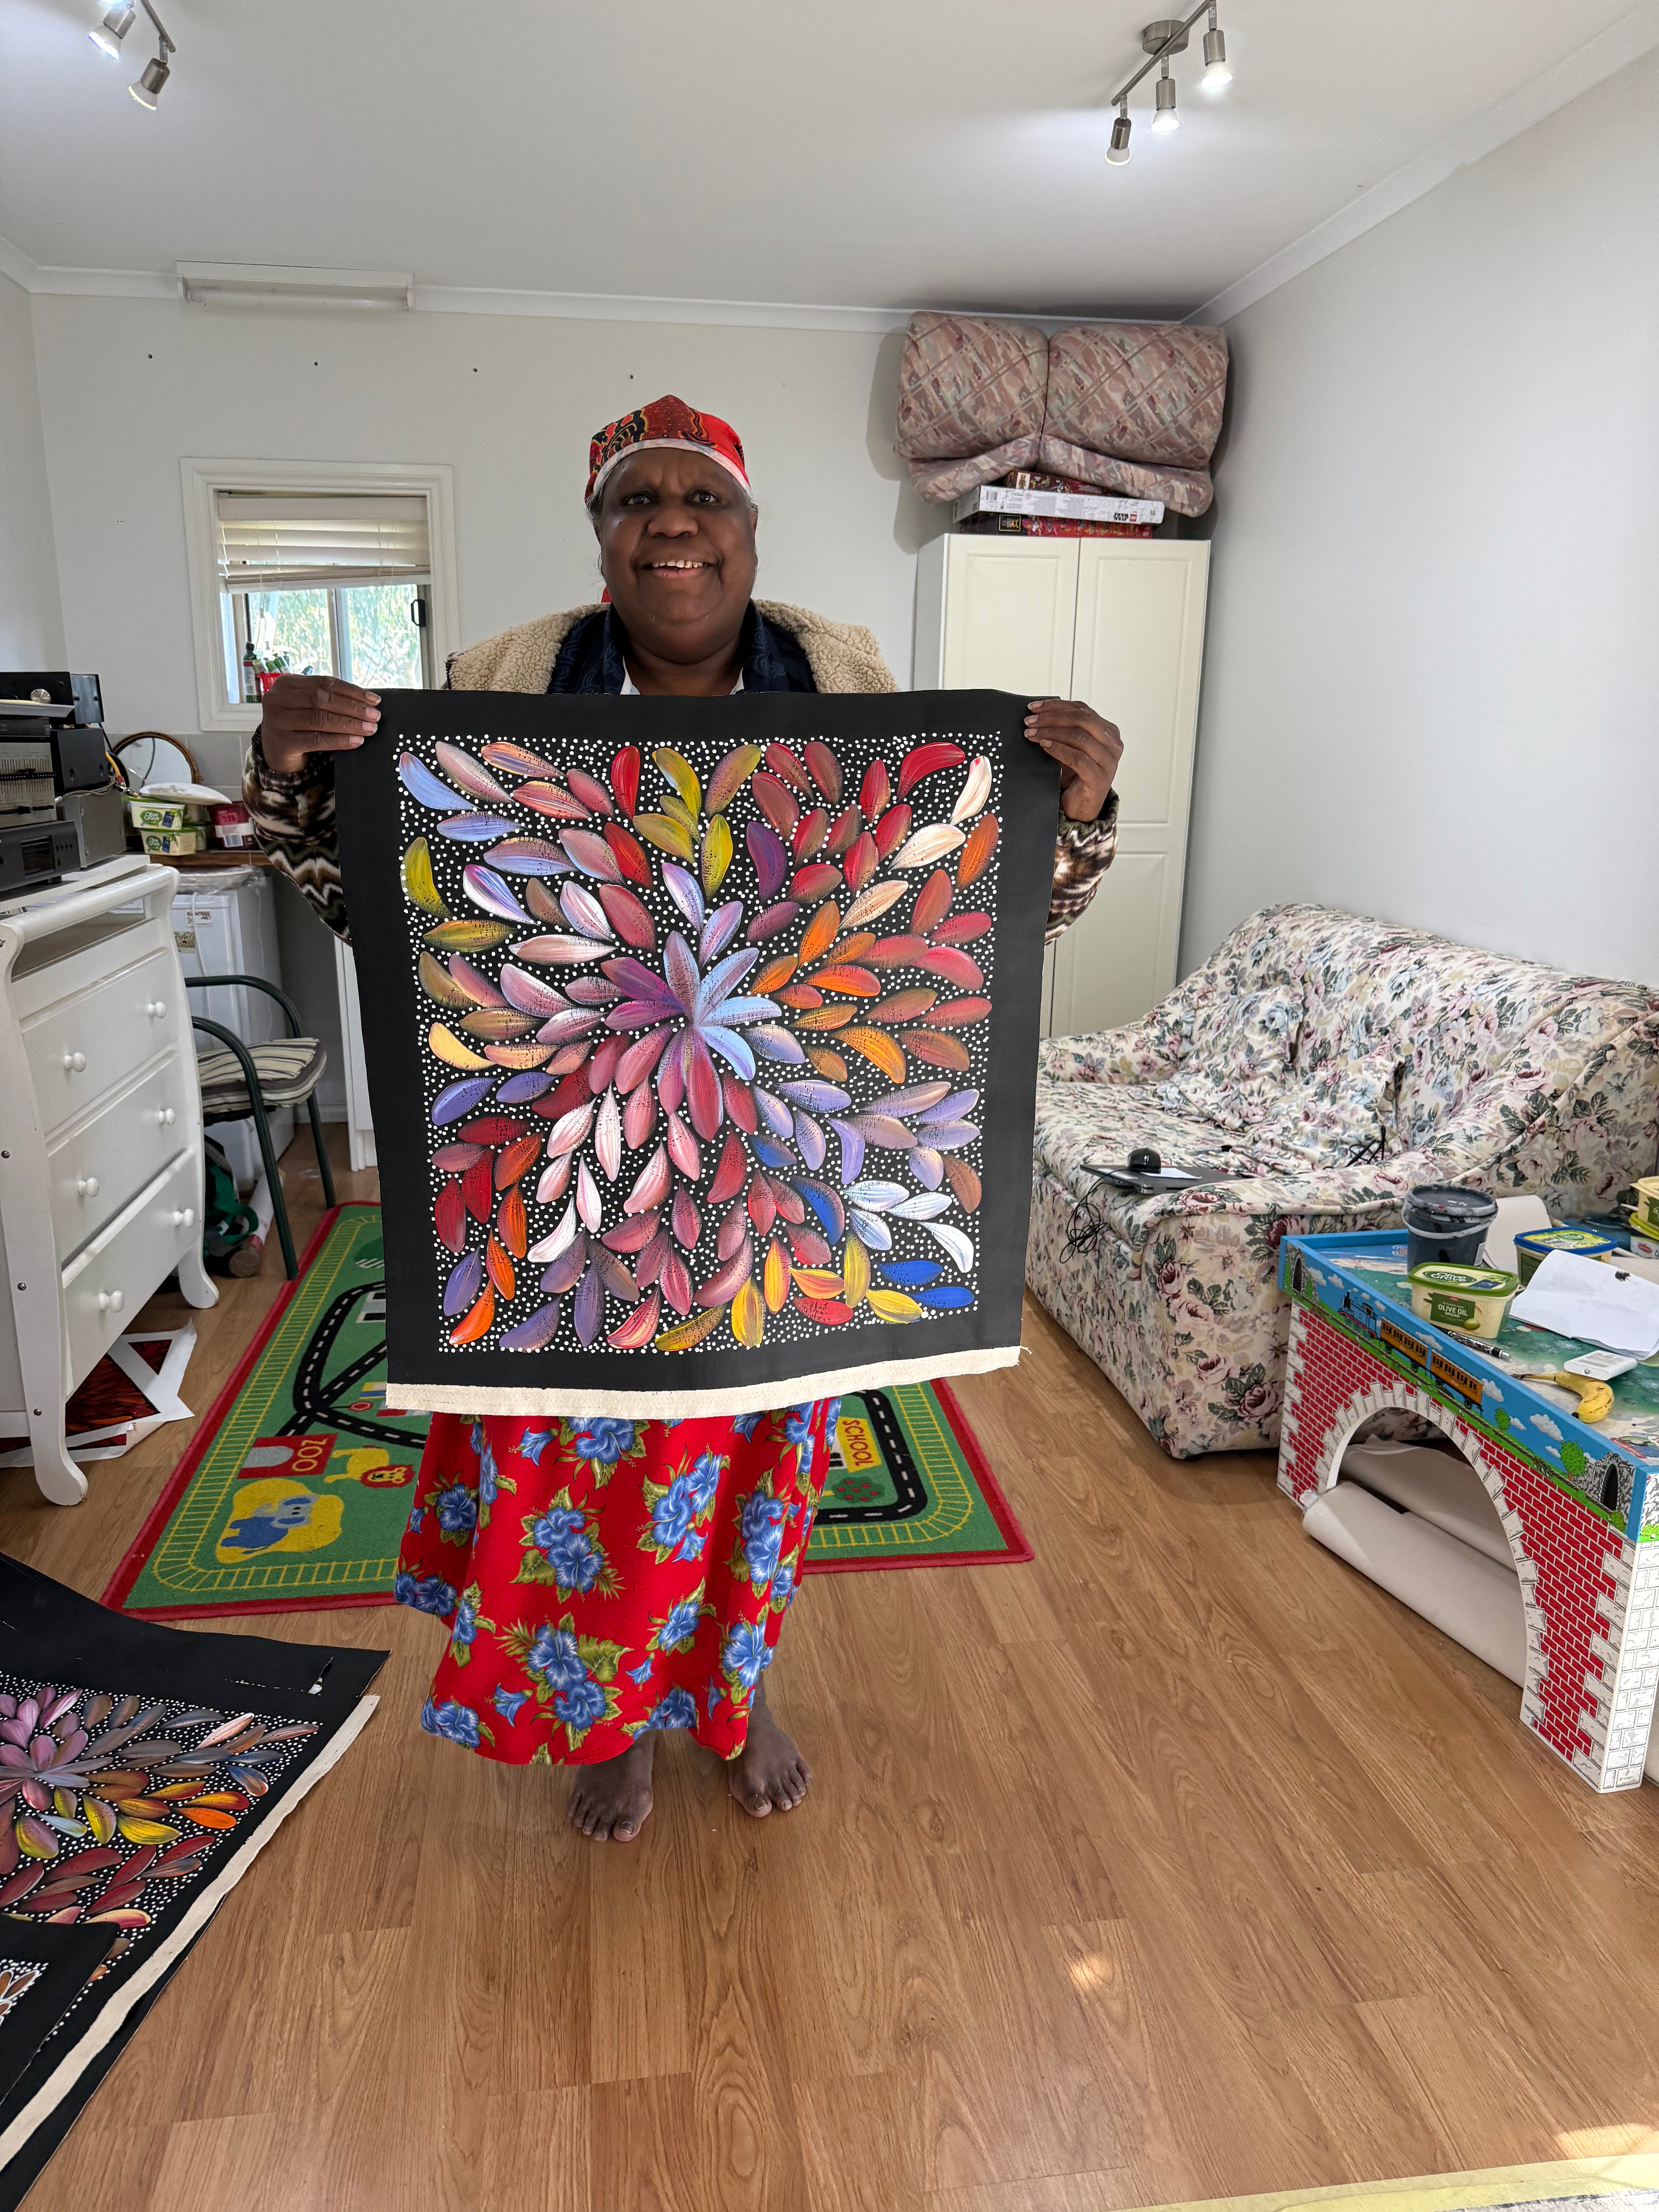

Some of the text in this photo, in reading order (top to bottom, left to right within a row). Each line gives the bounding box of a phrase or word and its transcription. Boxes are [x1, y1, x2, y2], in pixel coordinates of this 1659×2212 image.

[1438, 1304, 1456, 1313] OLIVE
[292, 1438, 327, 1472] ZOO
[842, 1420, 874, 1466] SCHOOL
